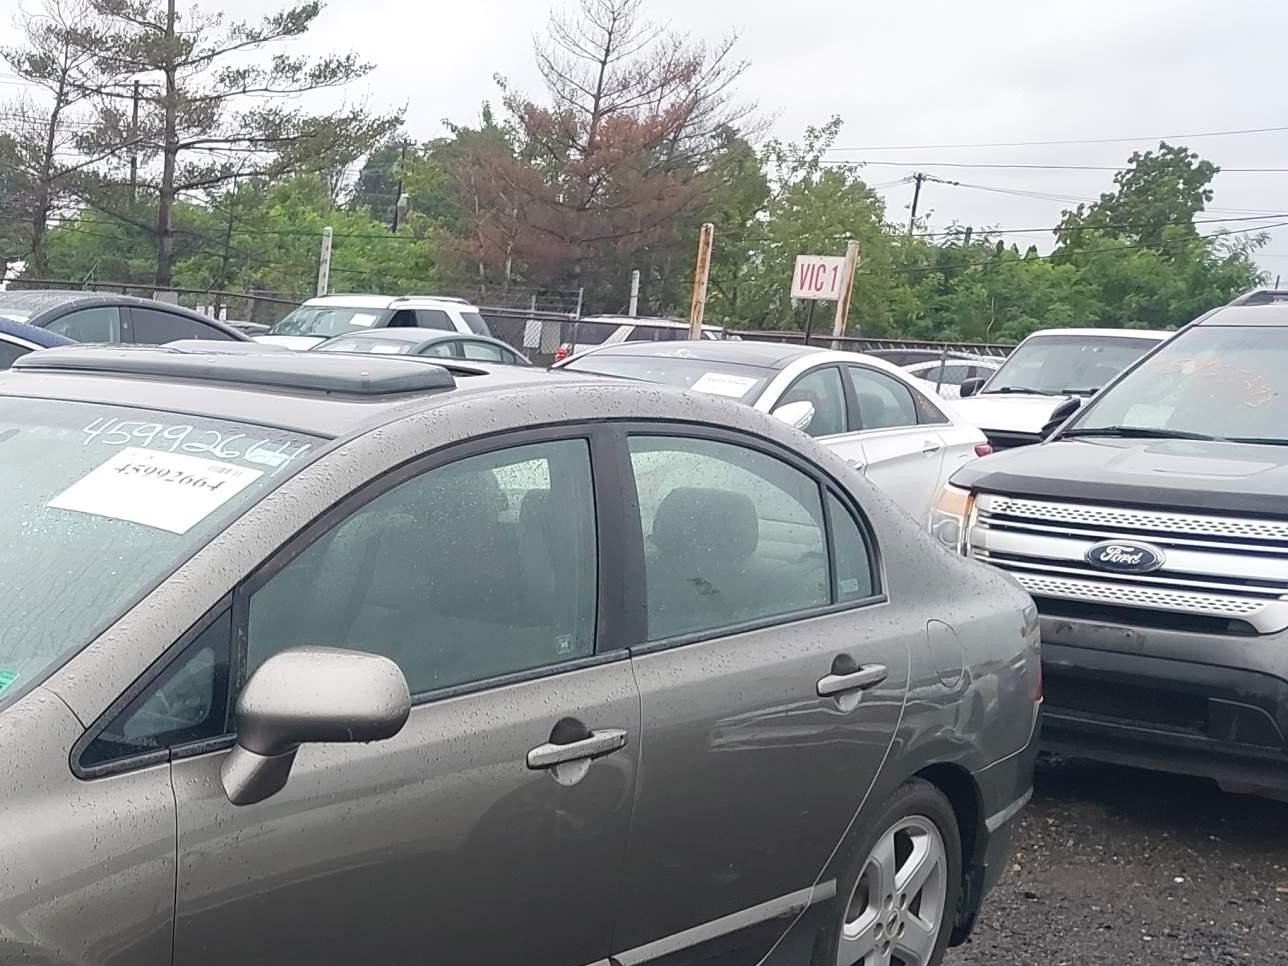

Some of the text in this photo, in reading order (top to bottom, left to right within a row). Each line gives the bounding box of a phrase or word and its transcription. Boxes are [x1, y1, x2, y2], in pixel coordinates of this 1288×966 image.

[800, 263, 839, 292] VIC 1
[82, 417, 312, 478] 45992664
[114, 463, 225, 491] 45992664
[1100, 546, 1143, 564] Ford
